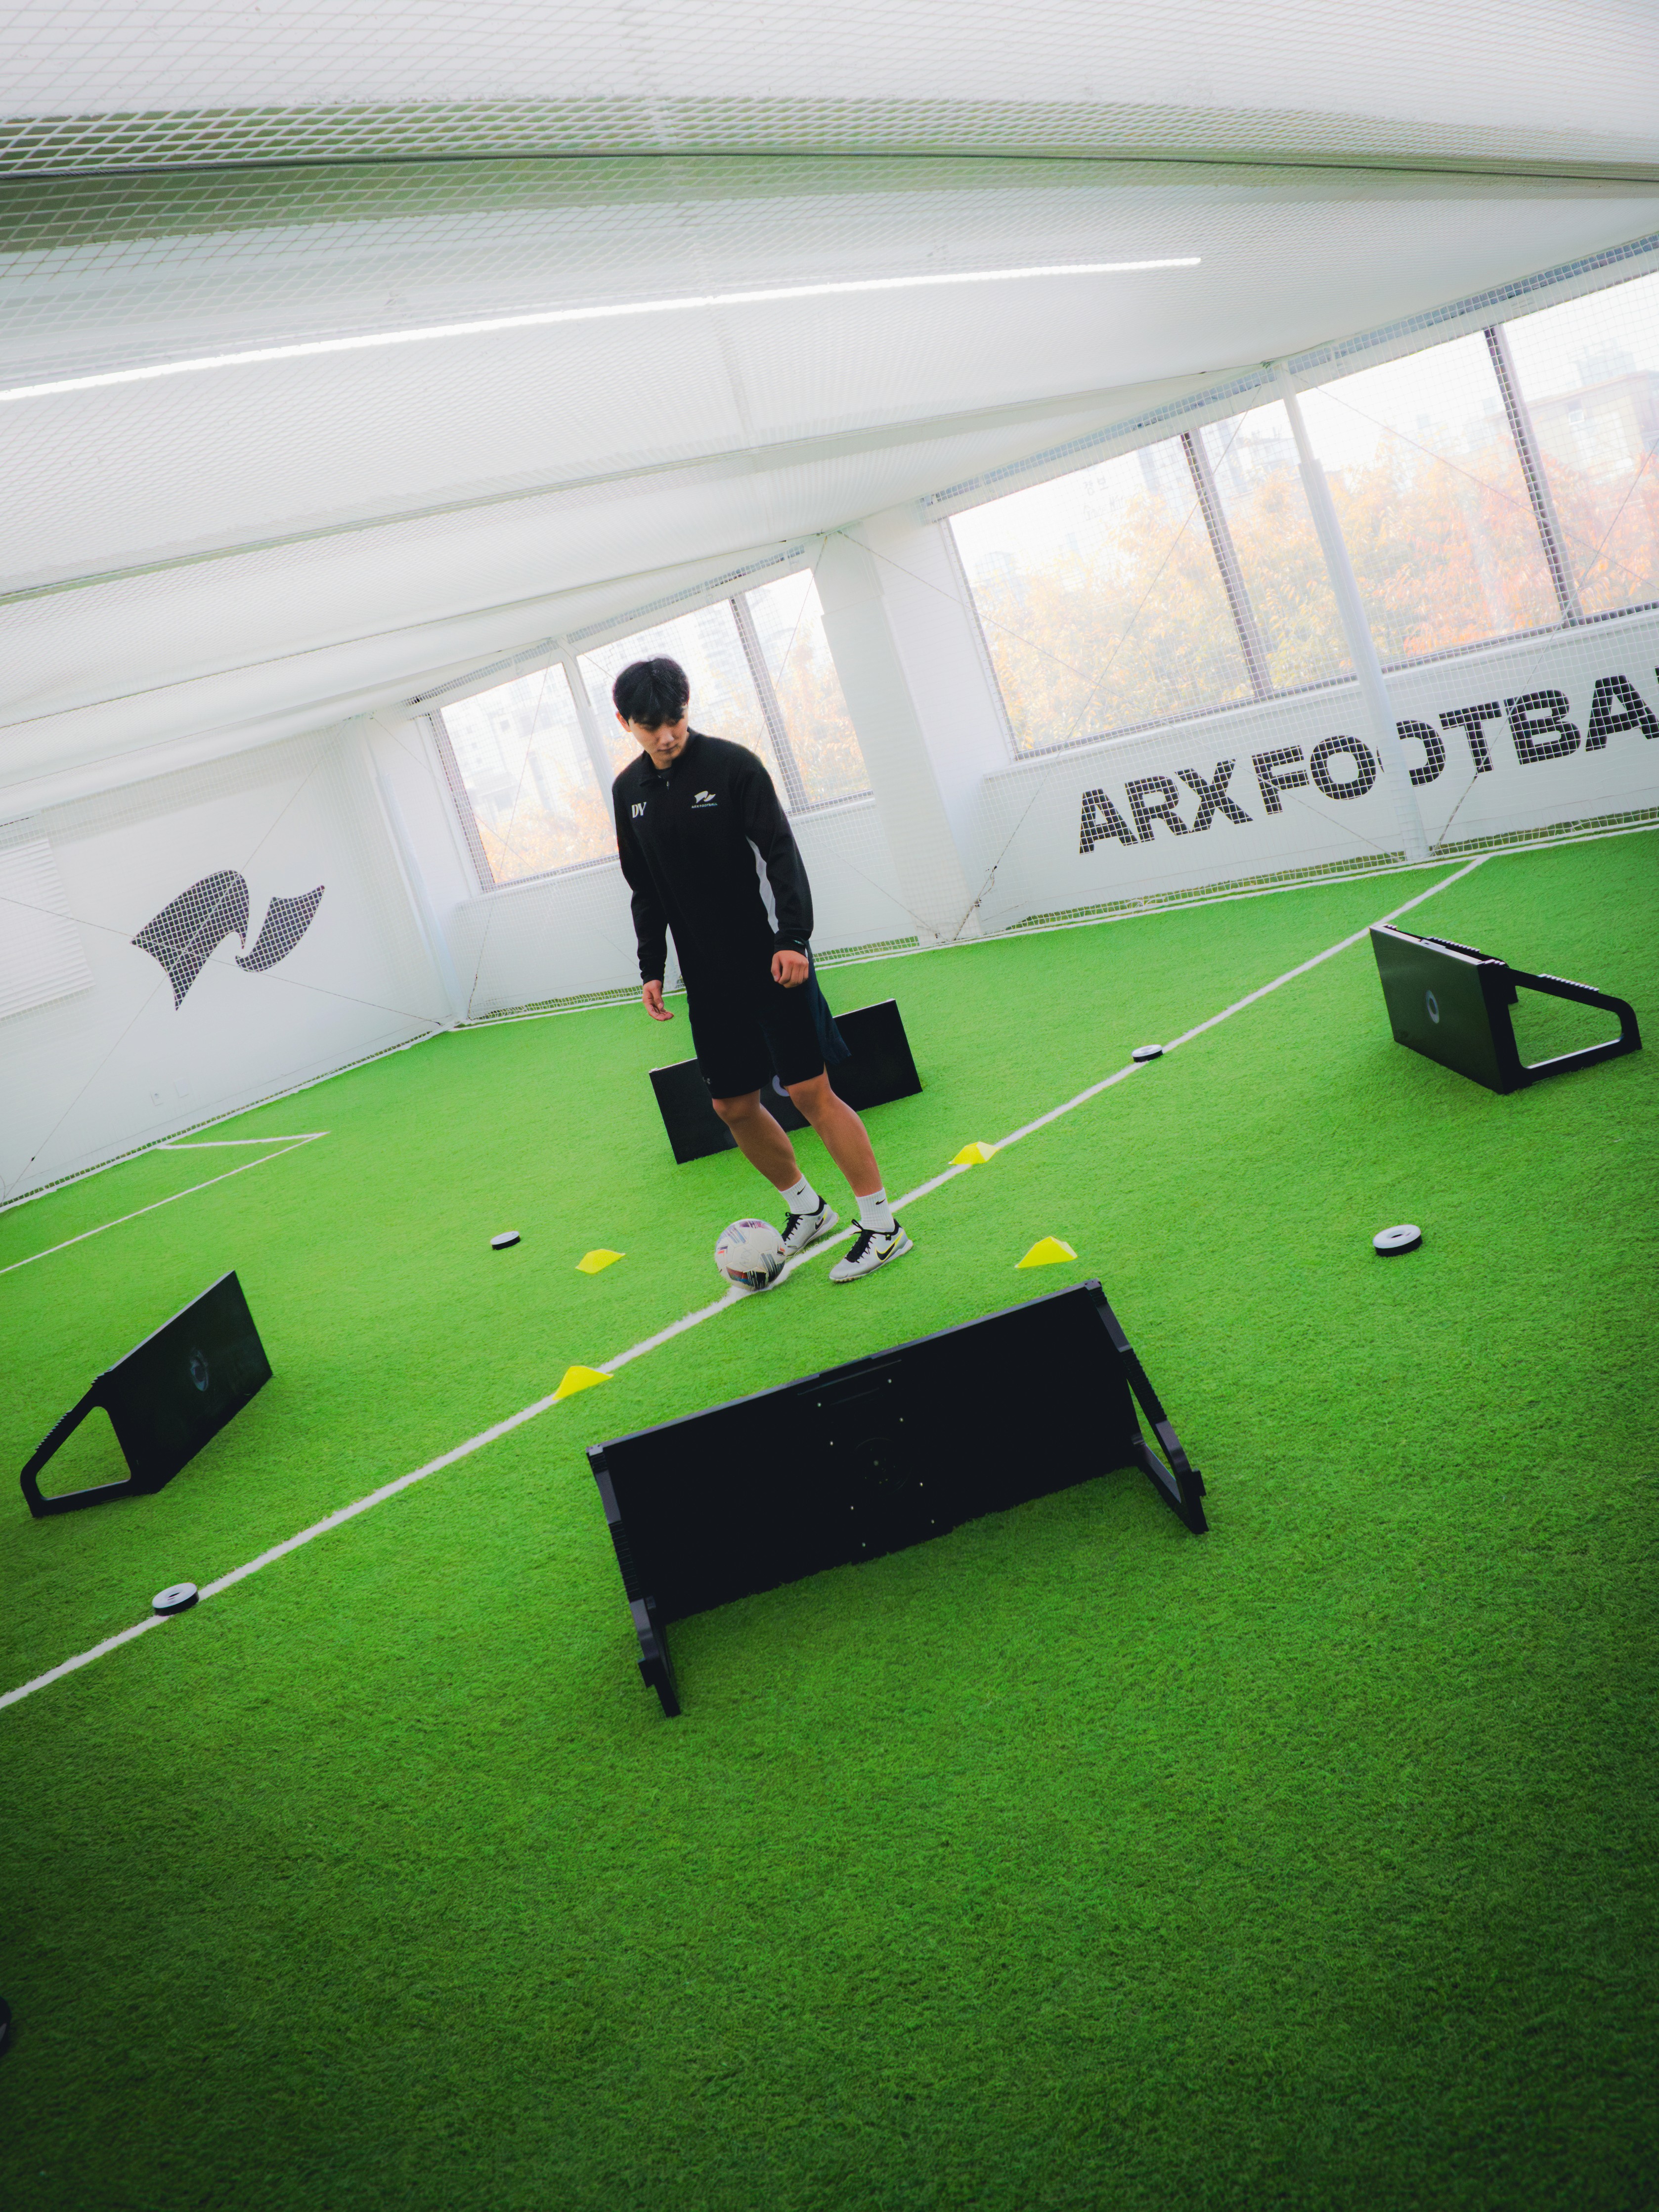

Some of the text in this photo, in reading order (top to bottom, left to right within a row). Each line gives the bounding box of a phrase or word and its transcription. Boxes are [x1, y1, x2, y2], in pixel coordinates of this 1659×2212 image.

[632, 801, 647, 818] DY
[1079, 665, 1659, 855] ARX FOOTBA
